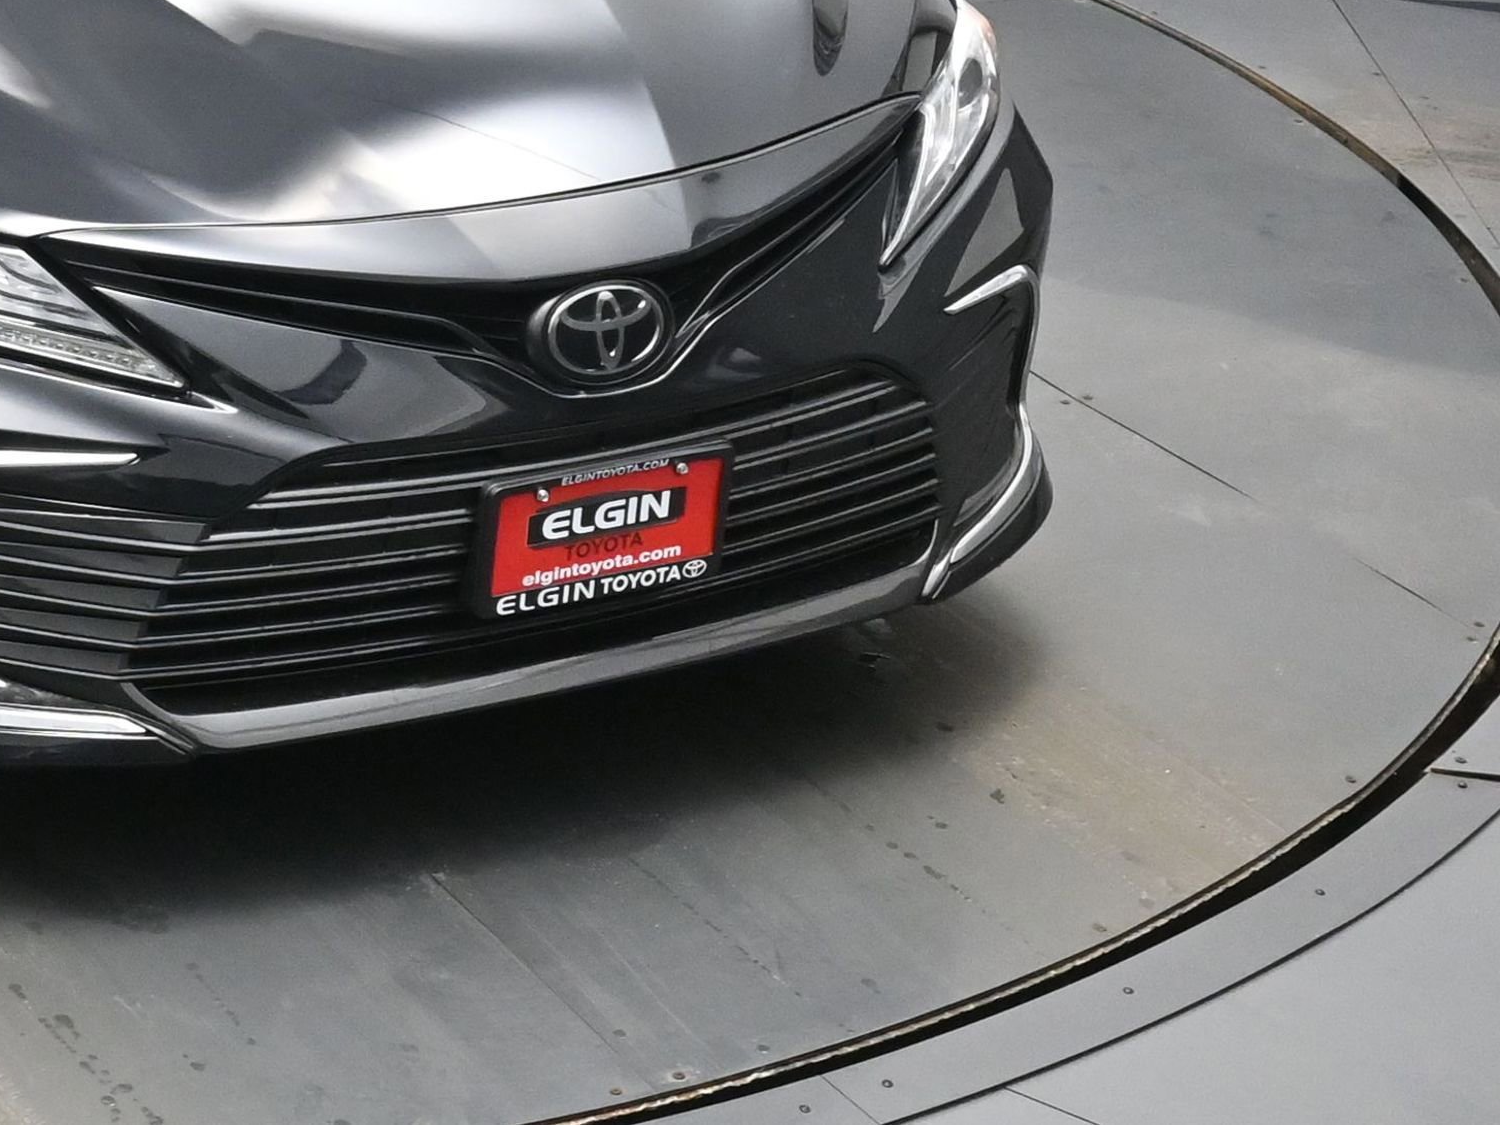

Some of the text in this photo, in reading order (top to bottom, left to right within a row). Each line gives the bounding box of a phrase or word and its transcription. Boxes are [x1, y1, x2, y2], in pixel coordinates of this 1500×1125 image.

[561, 458, 670, 487] ELGINTOYOTA.COM
[541, 489, 672, 541] ELGIN
[521, 544, 682, 588] elgintoyota.com
[565, 531, 644, 562] TOYOTA
[495, 563, 682, 616] ELGIN TOYOTA
